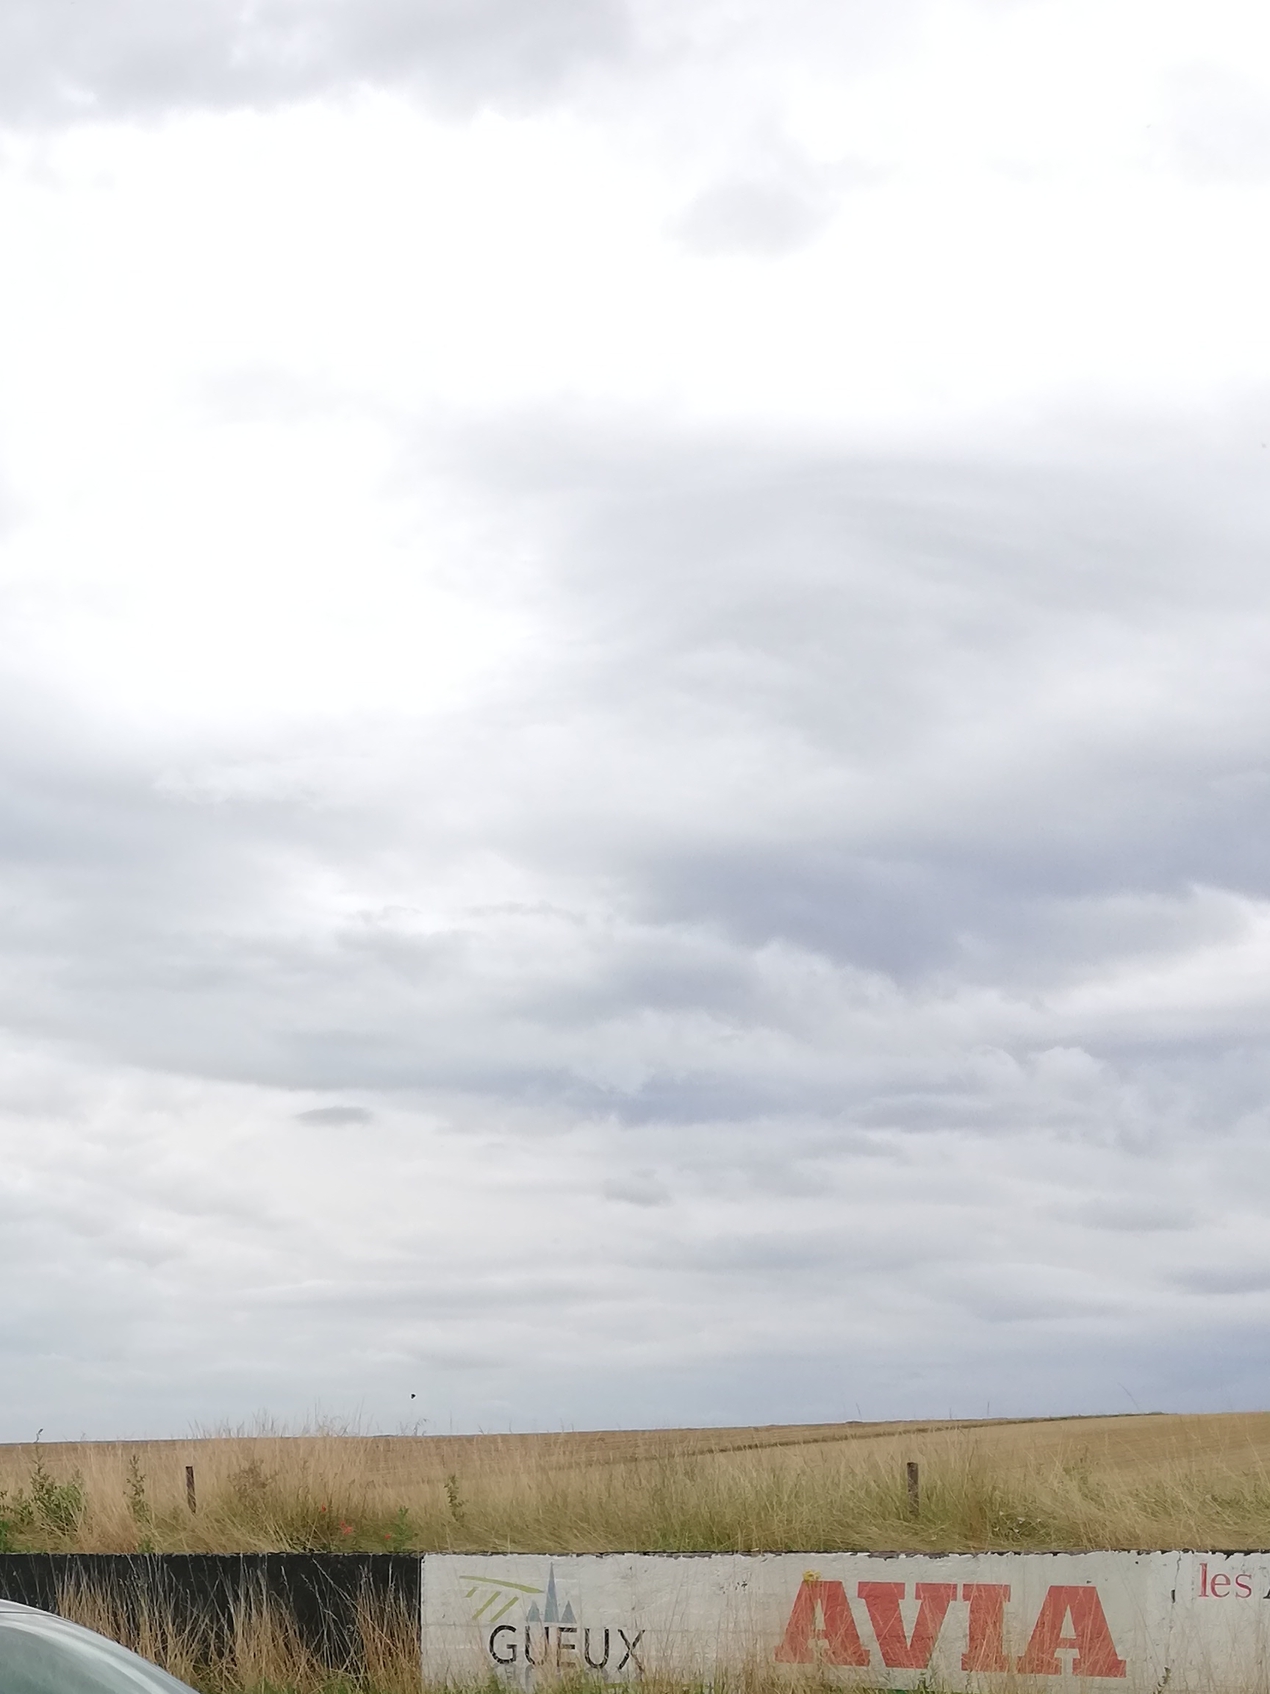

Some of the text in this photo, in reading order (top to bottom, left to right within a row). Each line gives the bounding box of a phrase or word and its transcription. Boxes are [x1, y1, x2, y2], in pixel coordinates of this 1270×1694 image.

[1198, 1563, 1252, 1598] les
[489, 1624, 646, 1672] GUEUX
[774, 1580, 1127, 1678] AVIA
